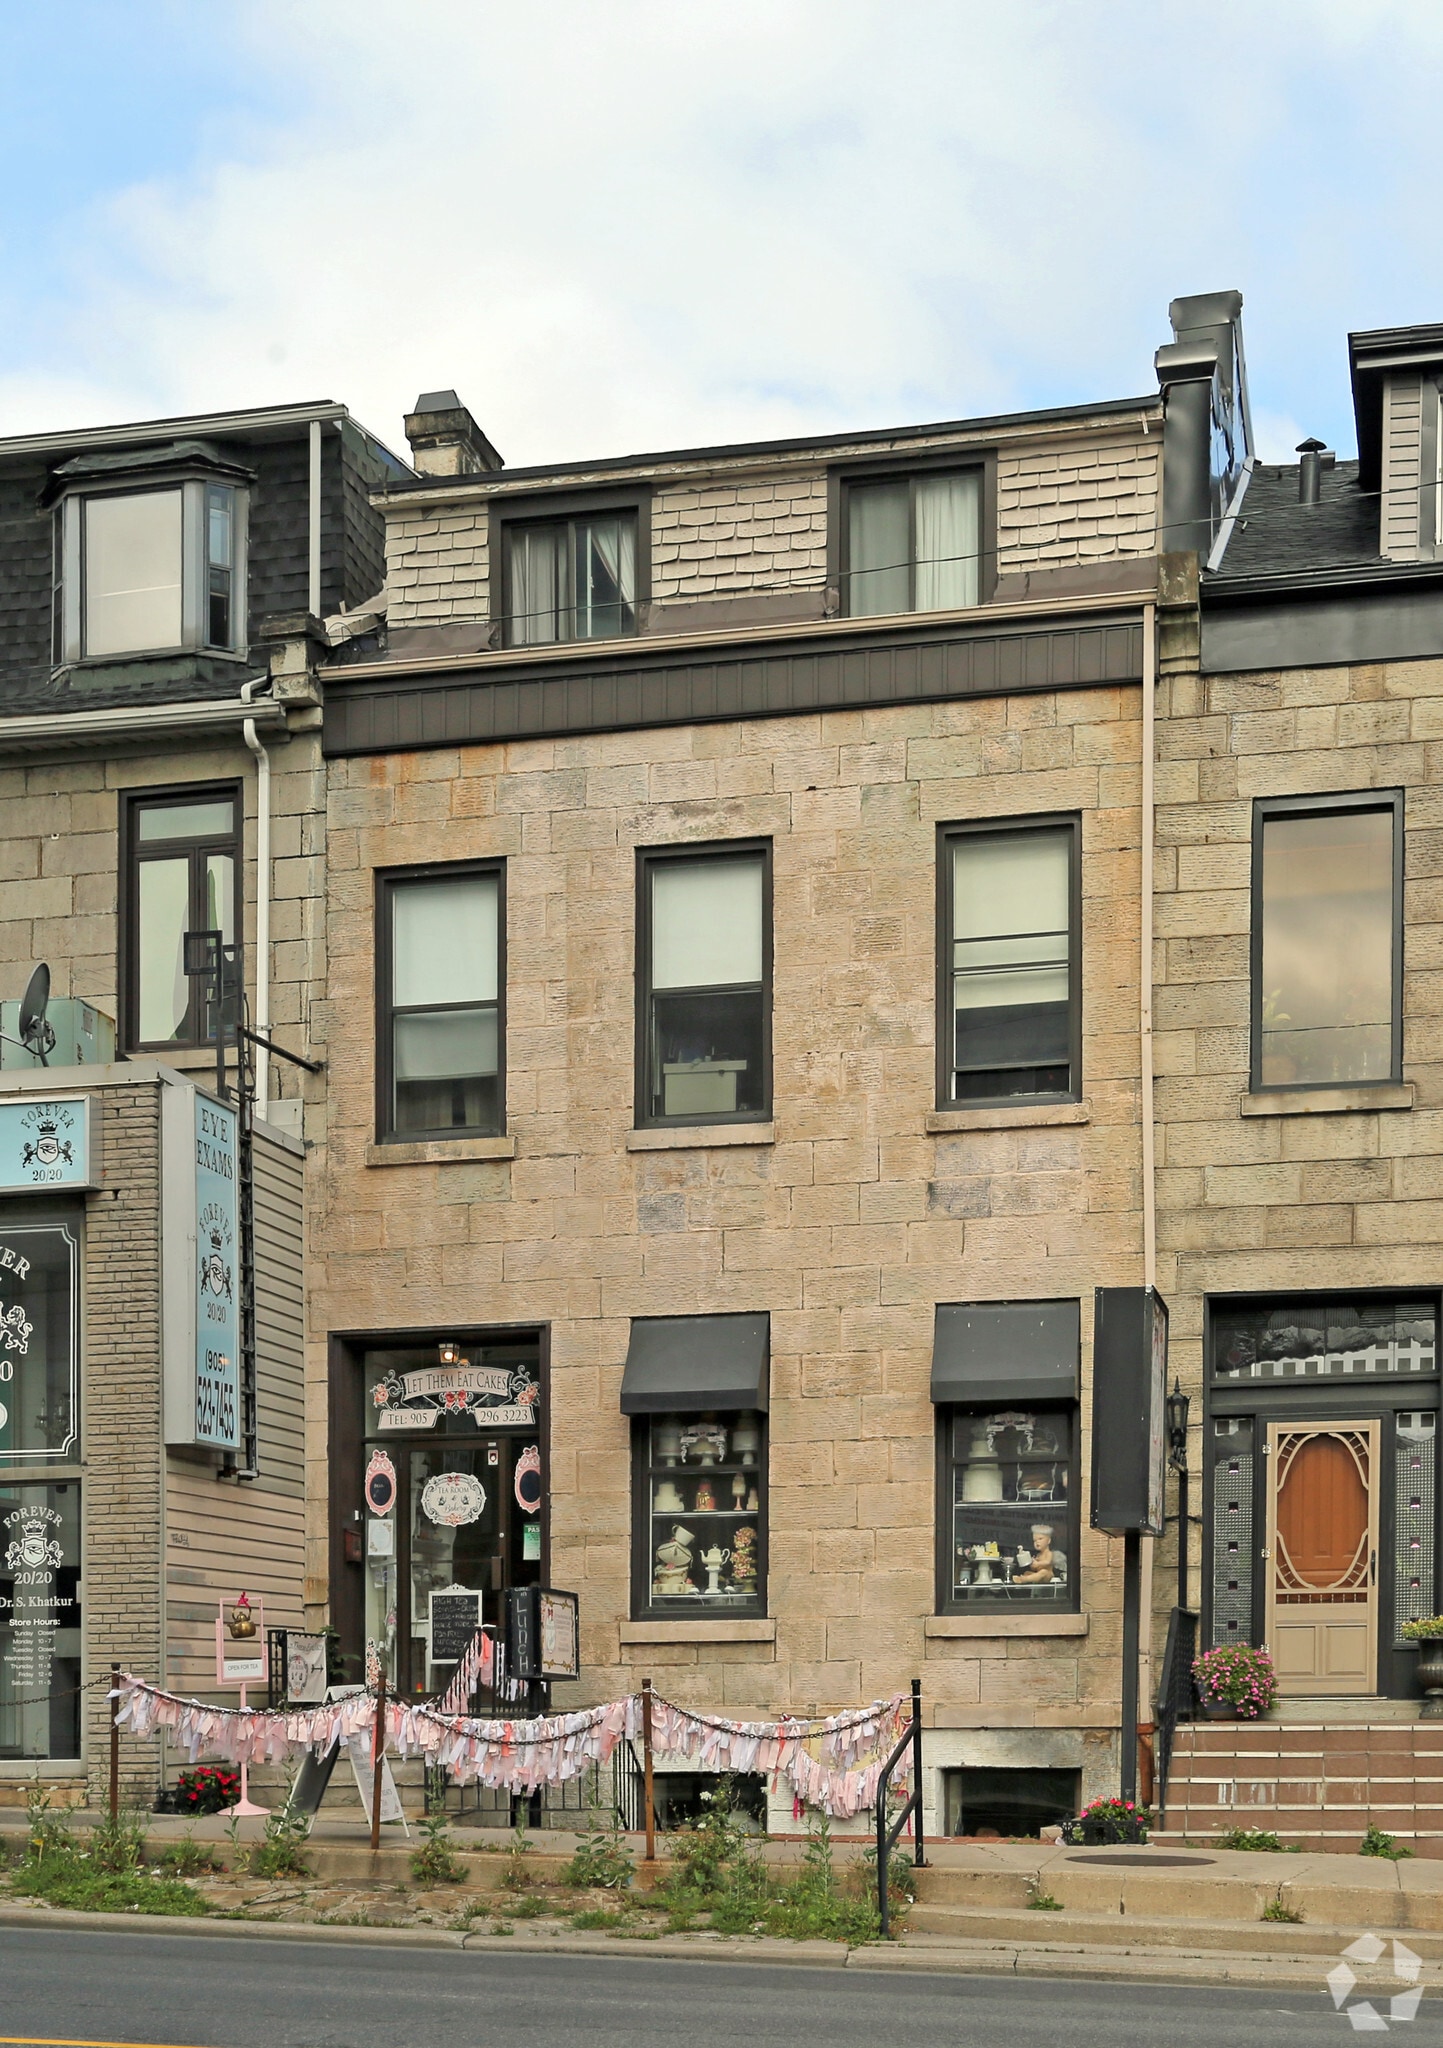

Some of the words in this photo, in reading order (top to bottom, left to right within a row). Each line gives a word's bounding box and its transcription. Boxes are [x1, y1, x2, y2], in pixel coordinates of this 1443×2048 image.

[20, 1103, 75, 1129] FOREVER
[201, 1108, 228, 1143] EYE
[197, 1138, 233, 1180] EXAMS
[32, 1168, 63, 1182] 20/20
[199, 1203, 232, 1245] FOREVER
[207, 1302, 227, 1324] 20/20
[205, 1348, 226, 1376] (905)
[406, 1377, 423, 1394] LET
[426, 1373, 454, 1390] THEM
[457, 1371, 474, 1387] EAT
[476, 1371, 507, 1391] CAKES
[197, 1376, 234, 1440] 523-7455
[387, 1413, 408, 1425] TEL:
[410, 1412, 428, 1425] 905
[480, 1410, 499, 1423] 296
[502, 1409, 528, 1423] 3223
[437, 1486, 449, 1494] TEA
[450, 1486, 469, 1494] ROOM
[3, 1505, 63, 1529] FOREVER
[14, 1571, 53, 1585] 20/20
[0, 1597, 14, 1608] Dr.
[16, 1596, 26, 1607] S.
[28, 1595, 73, 1607] Khatkur
[9, 1618, 32, 1627] Store
[33, 1618, 61, 1626] Hours:
[12, 1647, 34, 1655] Tuesday
